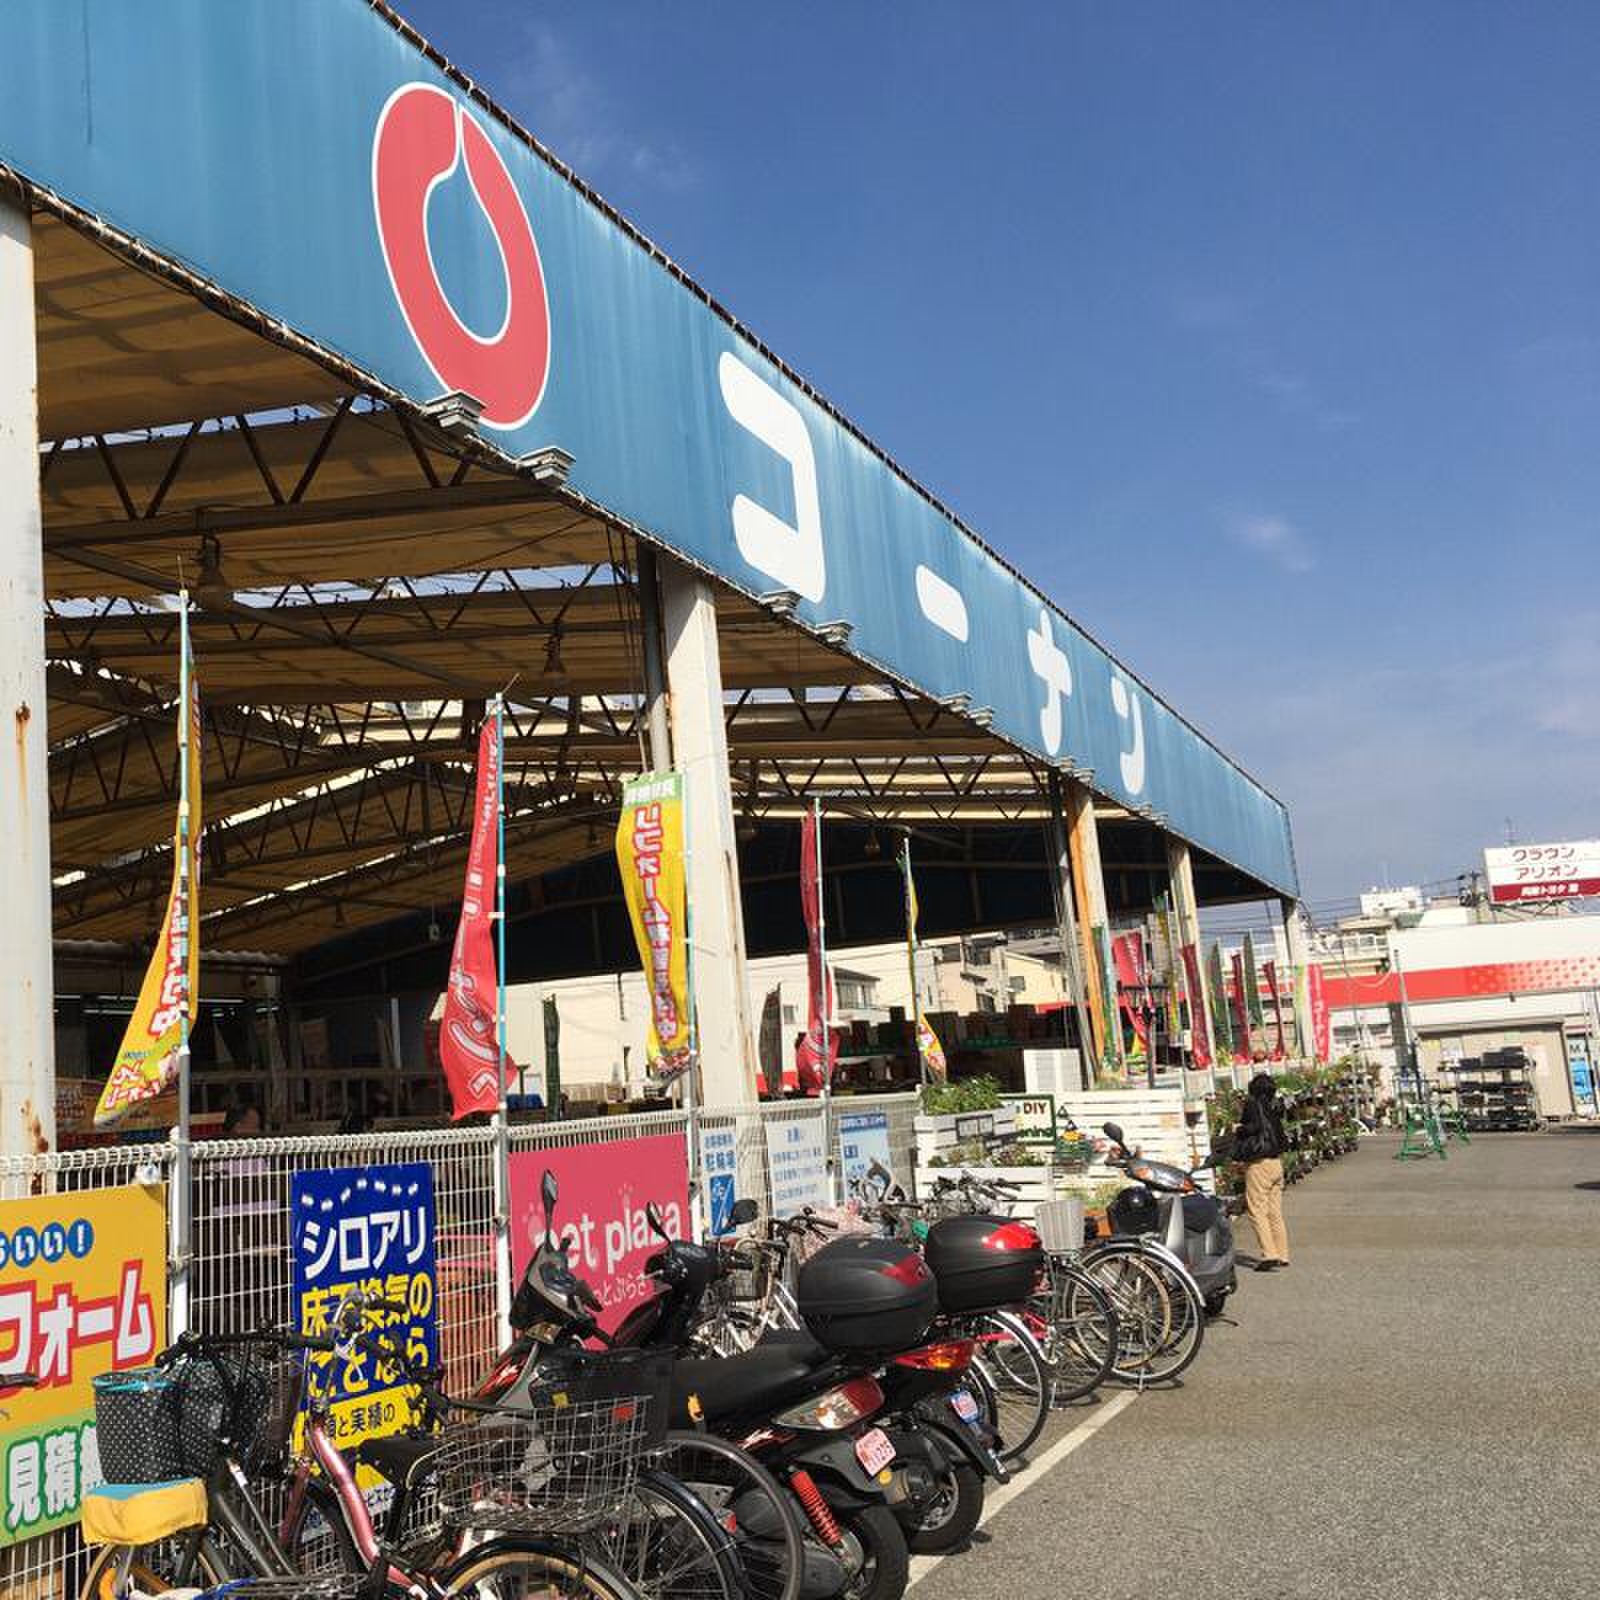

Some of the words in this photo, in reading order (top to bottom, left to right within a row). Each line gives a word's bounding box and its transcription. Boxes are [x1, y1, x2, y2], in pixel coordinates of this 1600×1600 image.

[720, 351, 1146, 795] コーナン
[1512, 847, 1576, 863] クラウン
[1514, 863, 1579, 881] アリオン
[1023, 1102, 1047, 1115] DIY
[0, 1222, 90, 1268] いい!
[303, 1206, 426, 1280] シロアリ
